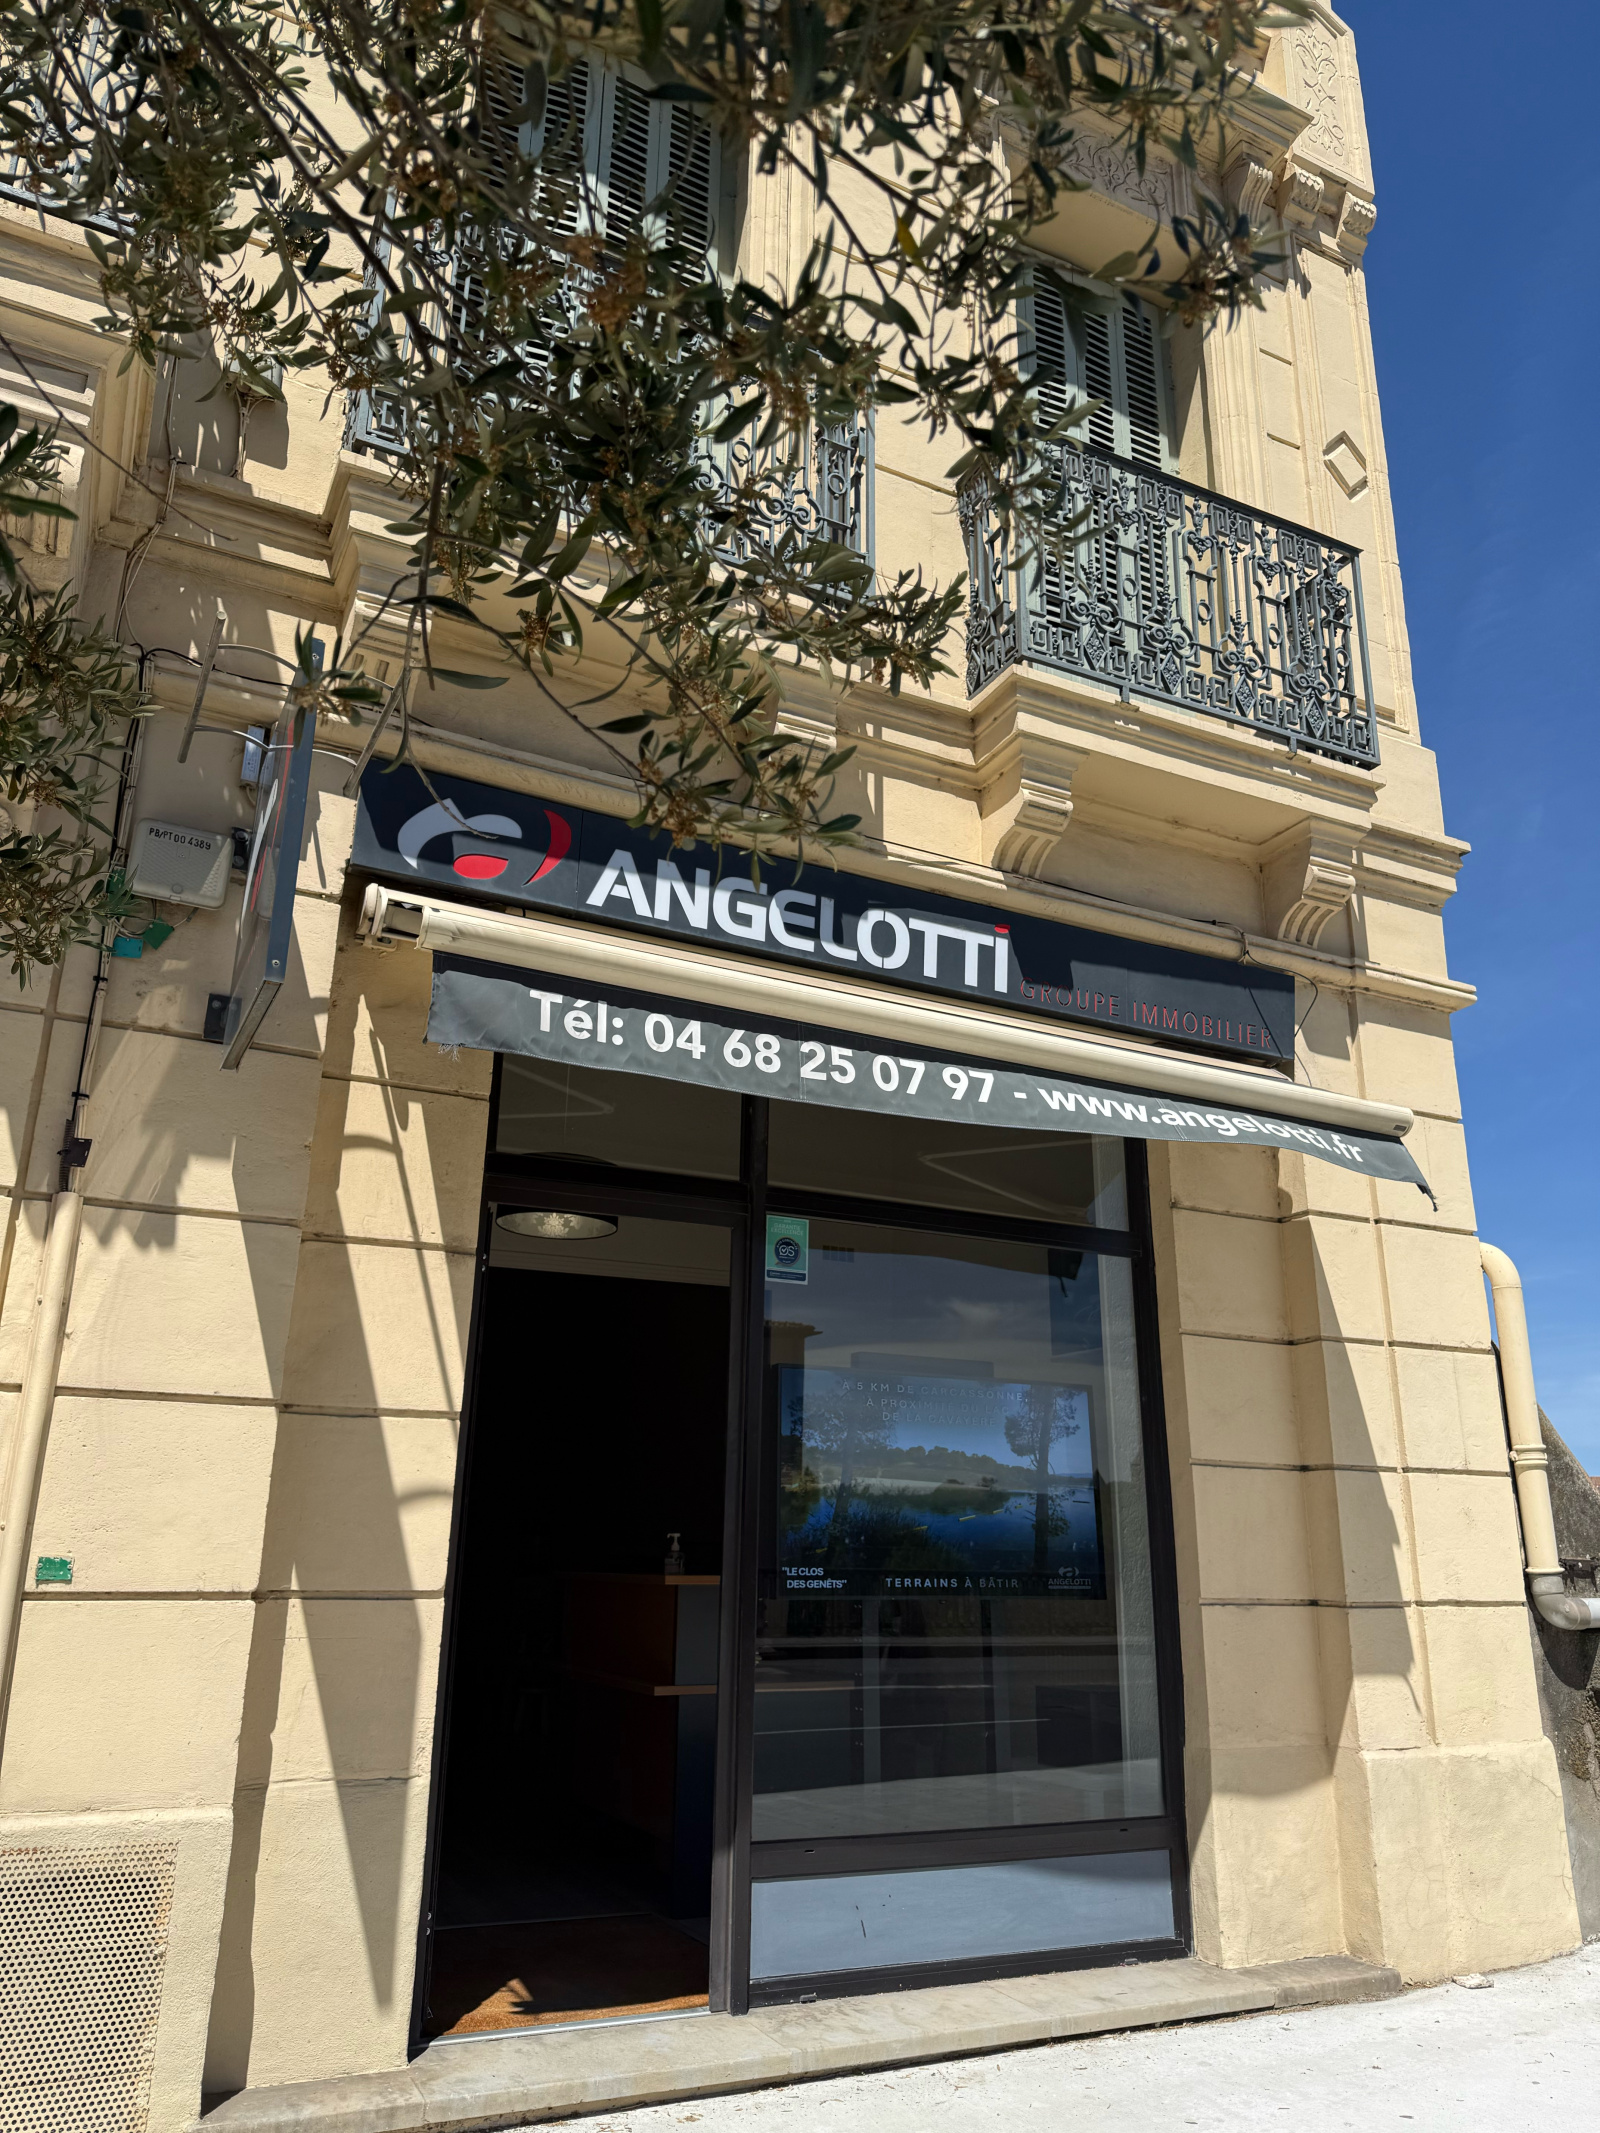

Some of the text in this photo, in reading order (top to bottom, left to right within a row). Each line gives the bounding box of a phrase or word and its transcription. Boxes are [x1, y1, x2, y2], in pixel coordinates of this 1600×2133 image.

[149, 827, 173, 841] PB/PT
[188, 837, 211, 850] 4389
[586, 848, 1011, 994] ANGELOTTI
[1020, 977, 1271, 1048] GROUPE IMMOBILIER
[530, 990, 624, 1046] Tél:
[644, 1012, 706, 1060] 04
[723, 1029, 781, 1074] 68
[800, 1040, 856, 1084] 25
[872, 1055, 925, 1095] 07
[942, 1066, 995, 1103] 97
[1037, 1087, 1364, 1162] www.angelotti.fr
[842, 1379, 1028, 1403] À 5 KM DE CARCASSONNE,
[882, 1411, 899, 1421] DE
[906, 1413, 922, 1422] LA
[961, 1403, 978, 1413] DU
[985, 1405, 1009, 1415] LAC
[782, 1567, 824, 1576] "LE CLOS
[786, 1578, 847, 1589] DES GENÊTS"
[886, 1576, 1019, 1588] TERRAINS À BÂTIR
